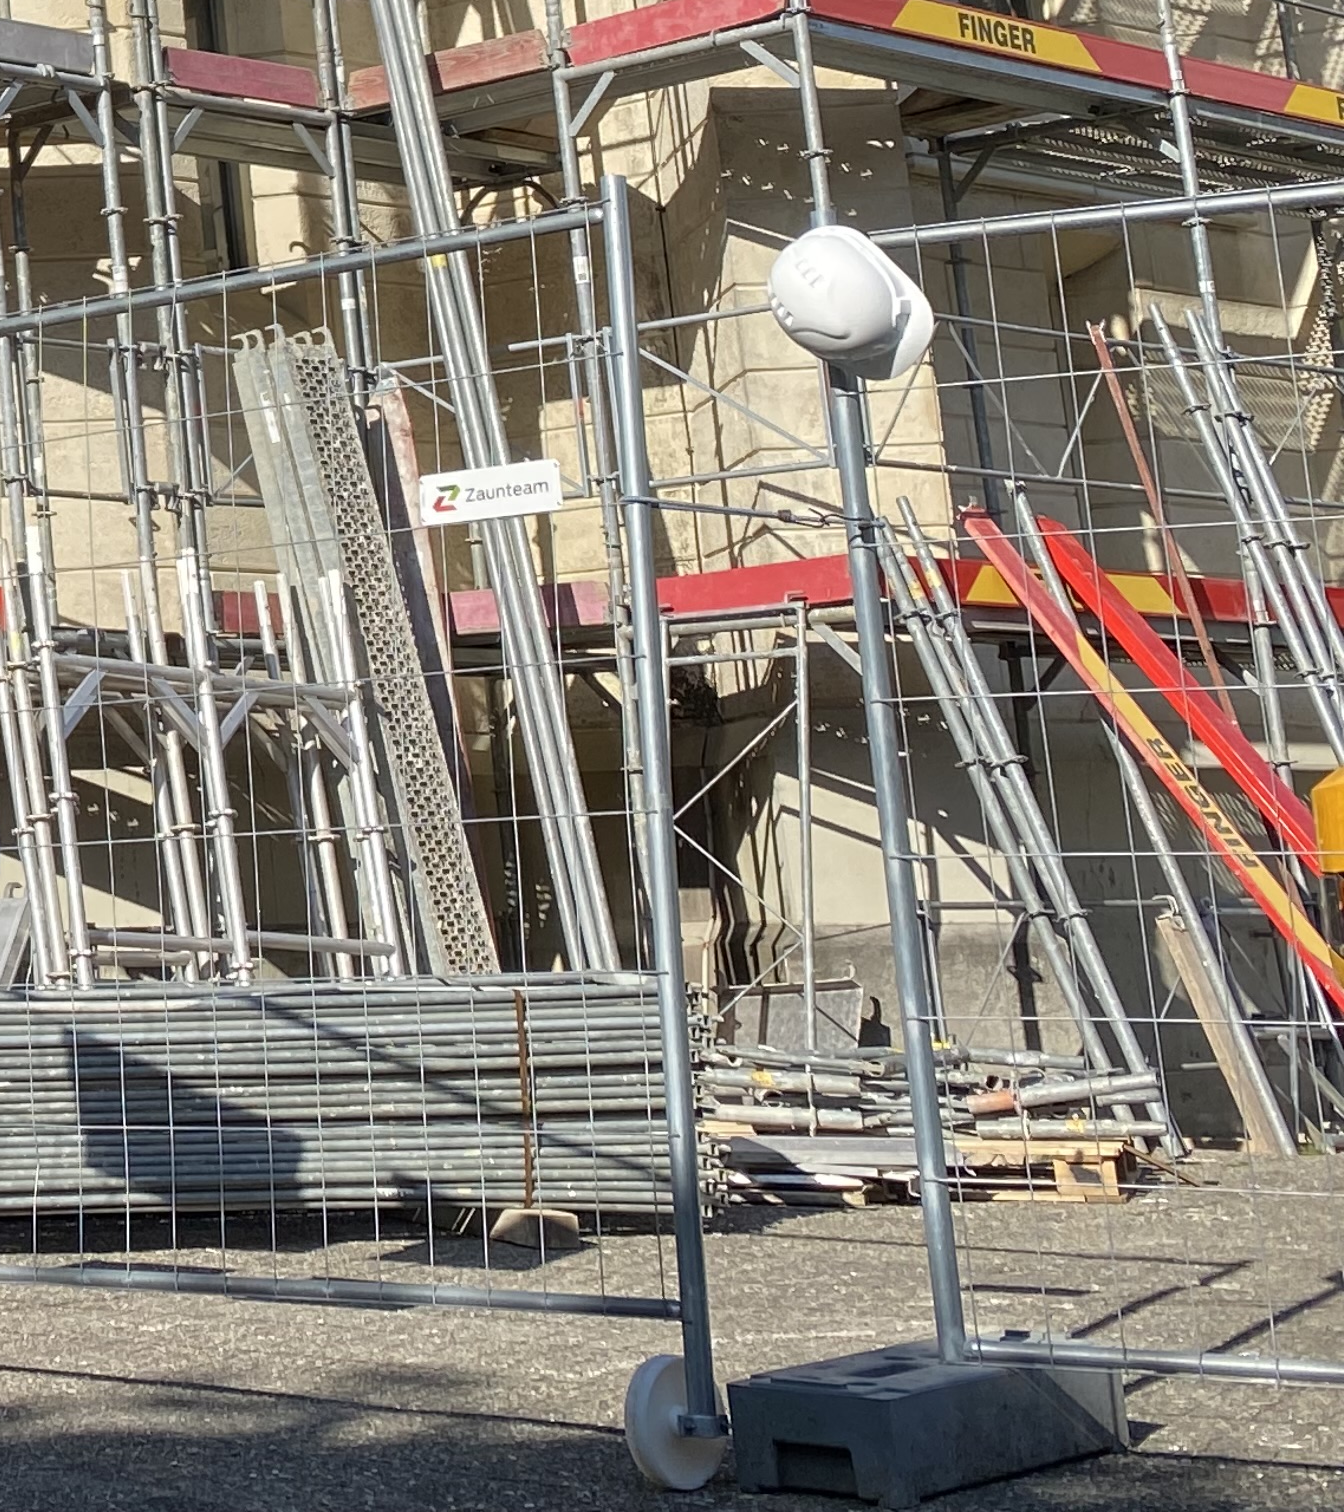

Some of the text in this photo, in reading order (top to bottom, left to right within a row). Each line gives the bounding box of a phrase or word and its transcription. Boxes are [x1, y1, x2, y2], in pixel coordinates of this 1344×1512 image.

[958, 11, 1038, 55] FINGER
[465, 481, 550, 503] Zaunteam
[1146, 738, 1260, 868] FINGER
